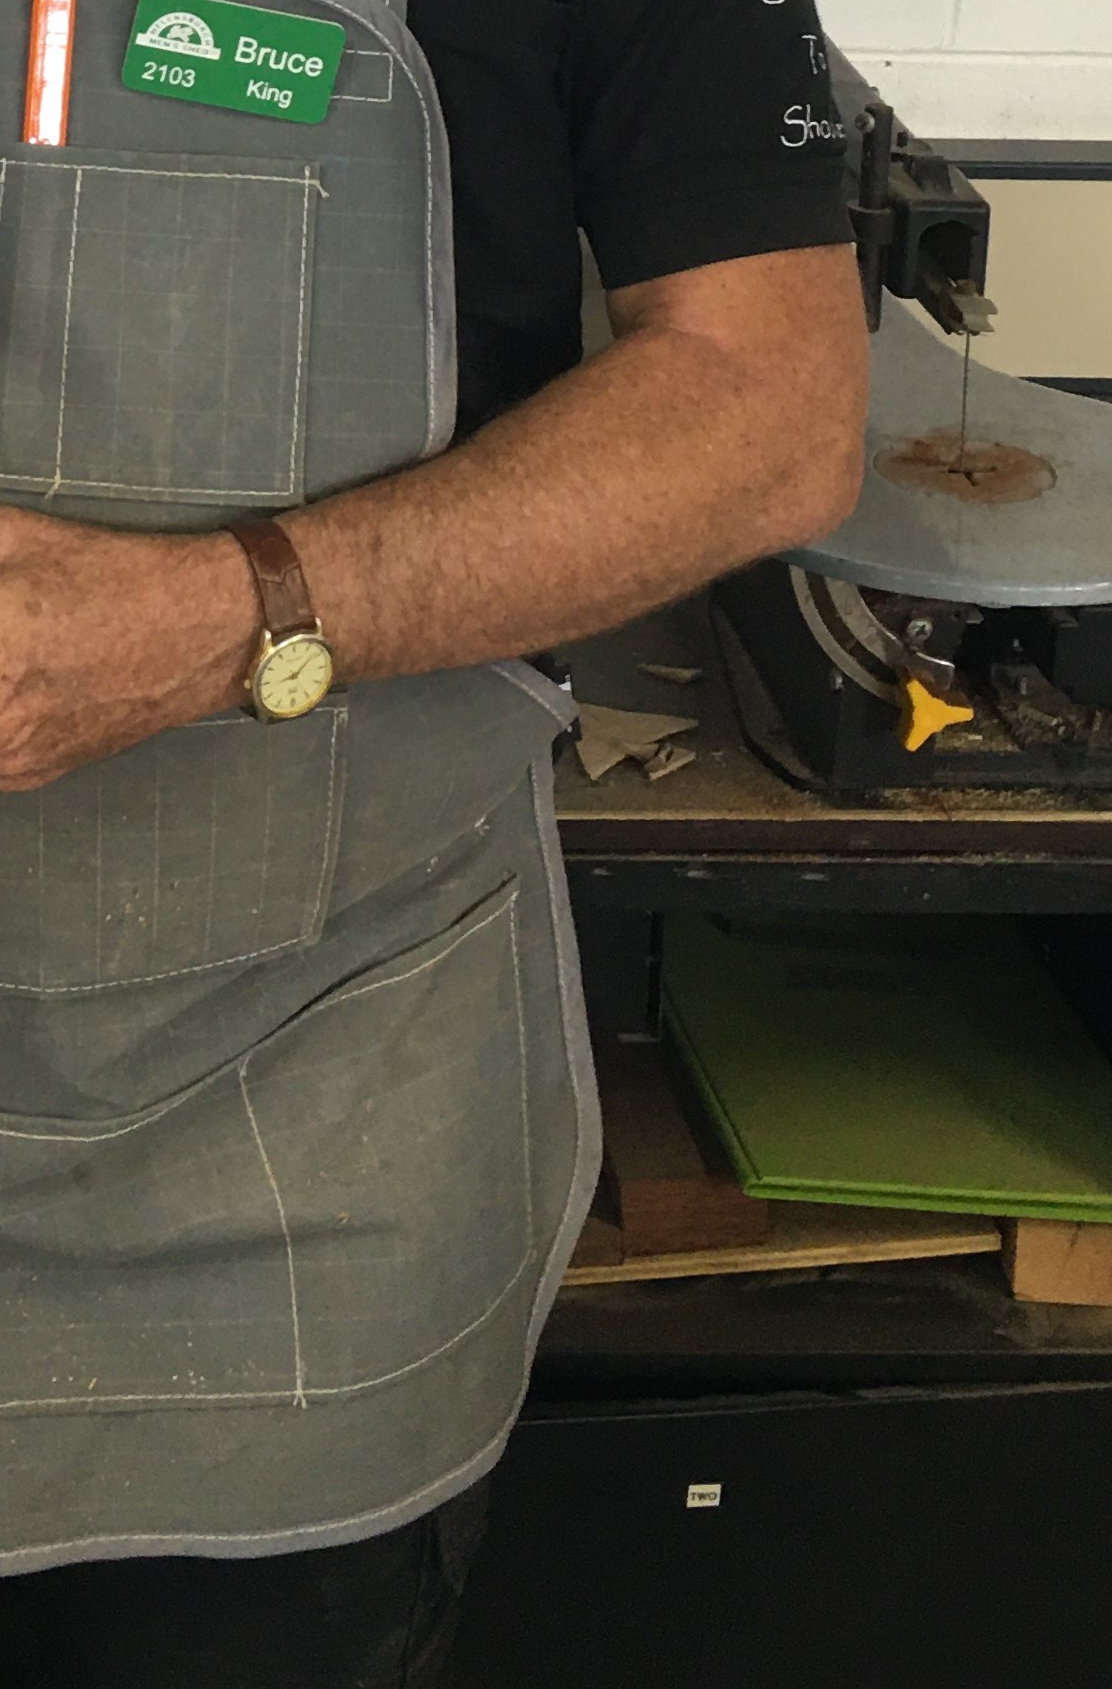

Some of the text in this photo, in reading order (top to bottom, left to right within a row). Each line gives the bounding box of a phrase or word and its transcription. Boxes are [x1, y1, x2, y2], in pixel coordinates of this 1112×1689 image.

[234, 36, 324, 78] Bruce
[141, 62, 196, 88] 2103
[246, 79, 293, 109] King
[689, 1491, 718, 1501] TWO
